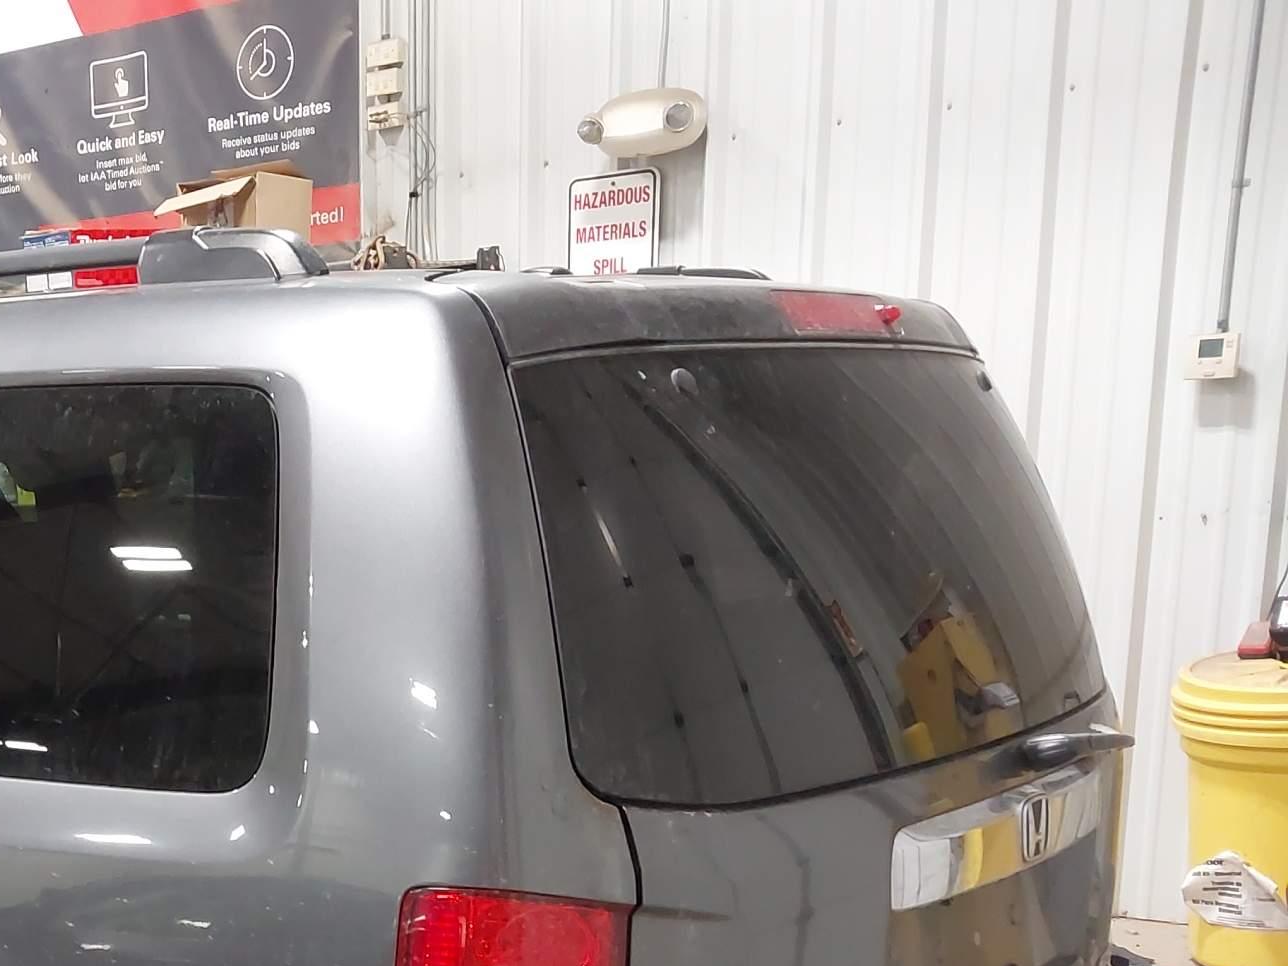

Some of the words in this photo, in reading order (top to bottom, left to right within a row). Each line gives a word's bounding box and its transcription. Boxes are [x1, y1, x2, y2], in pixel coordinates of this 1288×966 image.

[208, 111, 269, 132] Real-Time
[273, 101, 331, 123] Updates
[76, 136, 113, 154] Quick
[115, 132, 135, 149] and
[138, 130, 165, 144] Easy
[222, 136, 251, 148] Receive
[253, 132, 278, 143] status
[280, 126, 315, 140] updates
[11, 148, 39, 165] Look
[236, 148, 258, 159] about
[260, 144, 279, 157] your
[282, 140, 300, 151] bids
[78, 173, 89, 183] let
[91, 171, 106, 181] IAA
[106, 167, 128, 179] Timed
[129, 161, 164, 175] Auctions
[96, 159, 117, 169] Insert
[118, 157, 133, 165] max
[14, 172, 32, 182] they
[104, 181, 117, 191] bid
[117, 179, 127, 189] for
[128, 178, 142, 189] you
[574, 185, 650, 211] HAZARDOUS
[576, 220, 647, 244] MATERIALS
[593, 256, 627, 275] SPILL
